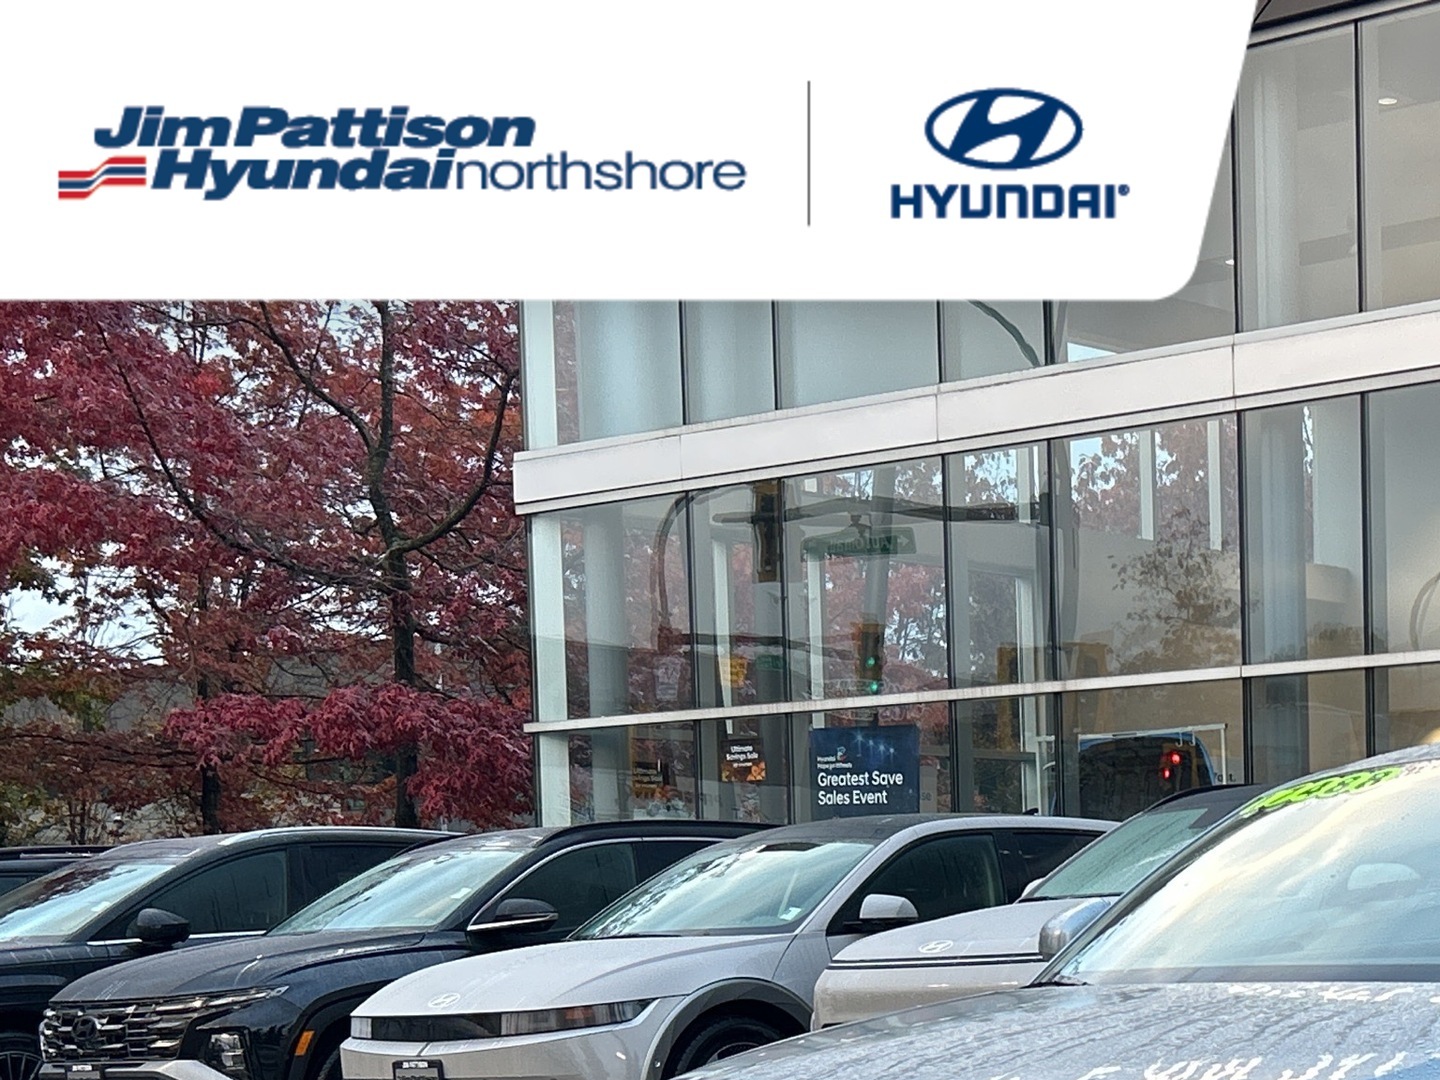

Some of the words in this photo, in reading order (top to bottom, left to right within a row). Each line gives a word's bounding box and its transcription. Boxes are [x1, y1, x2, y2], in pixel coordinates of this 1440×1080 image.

[817, 772, 870, 787] Greatest
[871, 770, 904, 786] Save
[817, 790, 850, 806] Sales
[852, 789, 888, 804] Event
